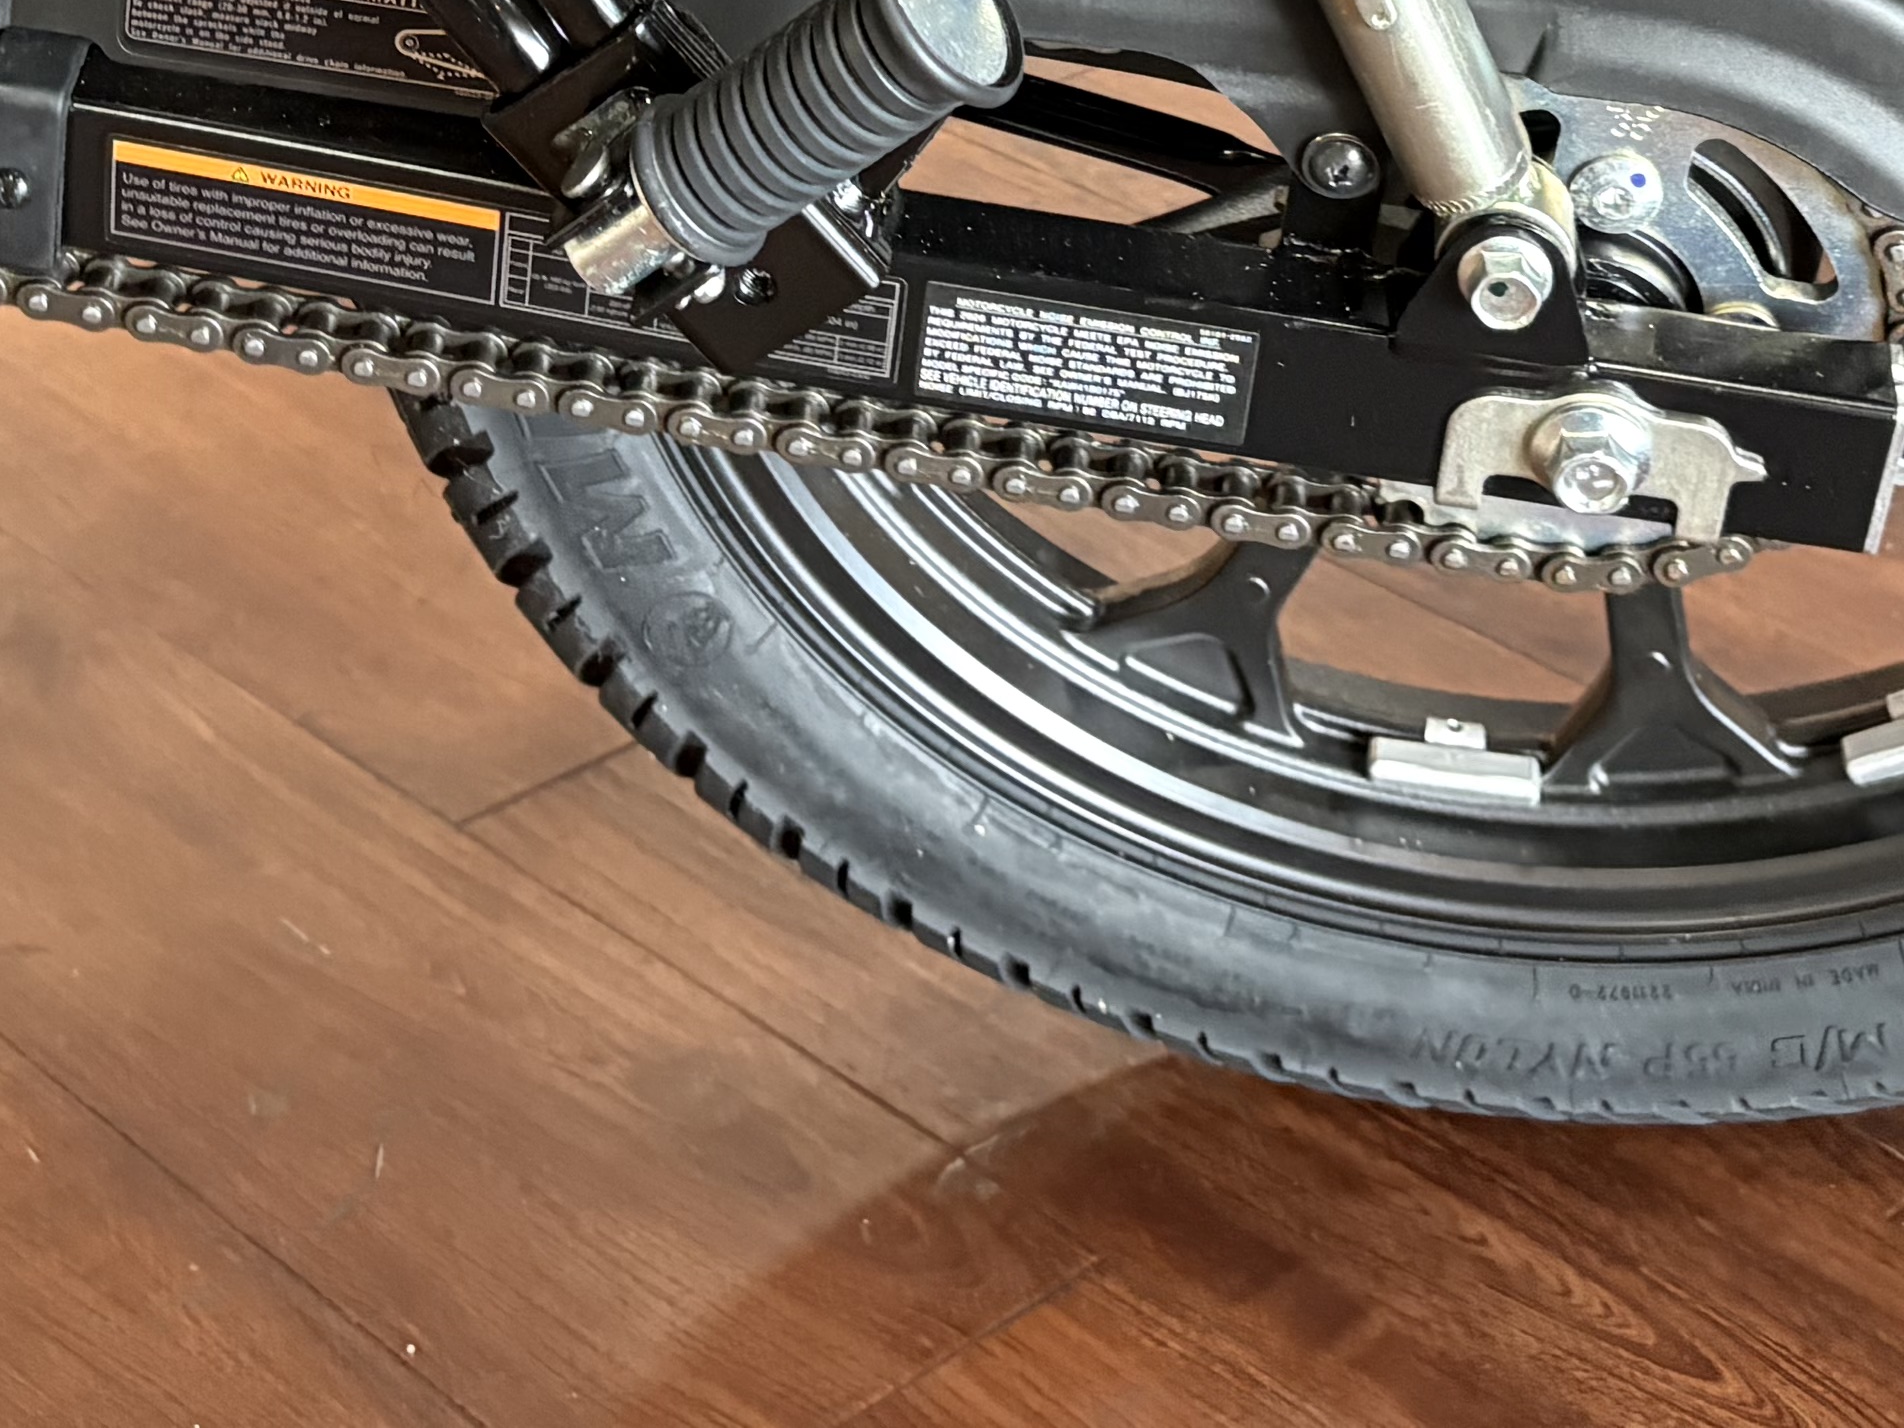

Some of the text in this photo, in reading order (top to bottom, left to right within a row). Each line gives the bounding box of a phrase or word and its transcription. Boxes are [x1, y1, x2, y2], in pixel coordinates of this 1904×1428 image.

[122, 171, 149, 188] Use
[152, 177, 165, 191] of
[168, 180, 198, 197] tires
[200, 186, 228, 202] with
[232, 192, 290, 214] improper
[294, 203, 346, 224] inflation
[349, 214, 363, 227] or
[366, 217, 433, 240] excessive
[260, 170, 352, 201] WARNING
[120, 200, 134, 214] in
[149, 205, 175, 222] loss
[179, 210, 192, 225] of
[195, 213, 241, 234] control
[243, 222, 296, 244] causing
[299, 233, 348, 254] serious
[351, 242, 391, 262] bodily
[120, 213, 148, 230] See
[150, 218, 206, 241] Owner's
[210, 229, 259, 251] Manual
[261, 239, 280, 255] for
[283, 243, 348, 268] additional
[121, 186, 475, 263] unsuitable replacement tires or overloading can result
[956, 297, 1034, 317] MOTORCYCLE
[990, 315, 1068, 336] MOTORCYCLE
[1135, 359, 1214, 380] MOTORCYCLE
